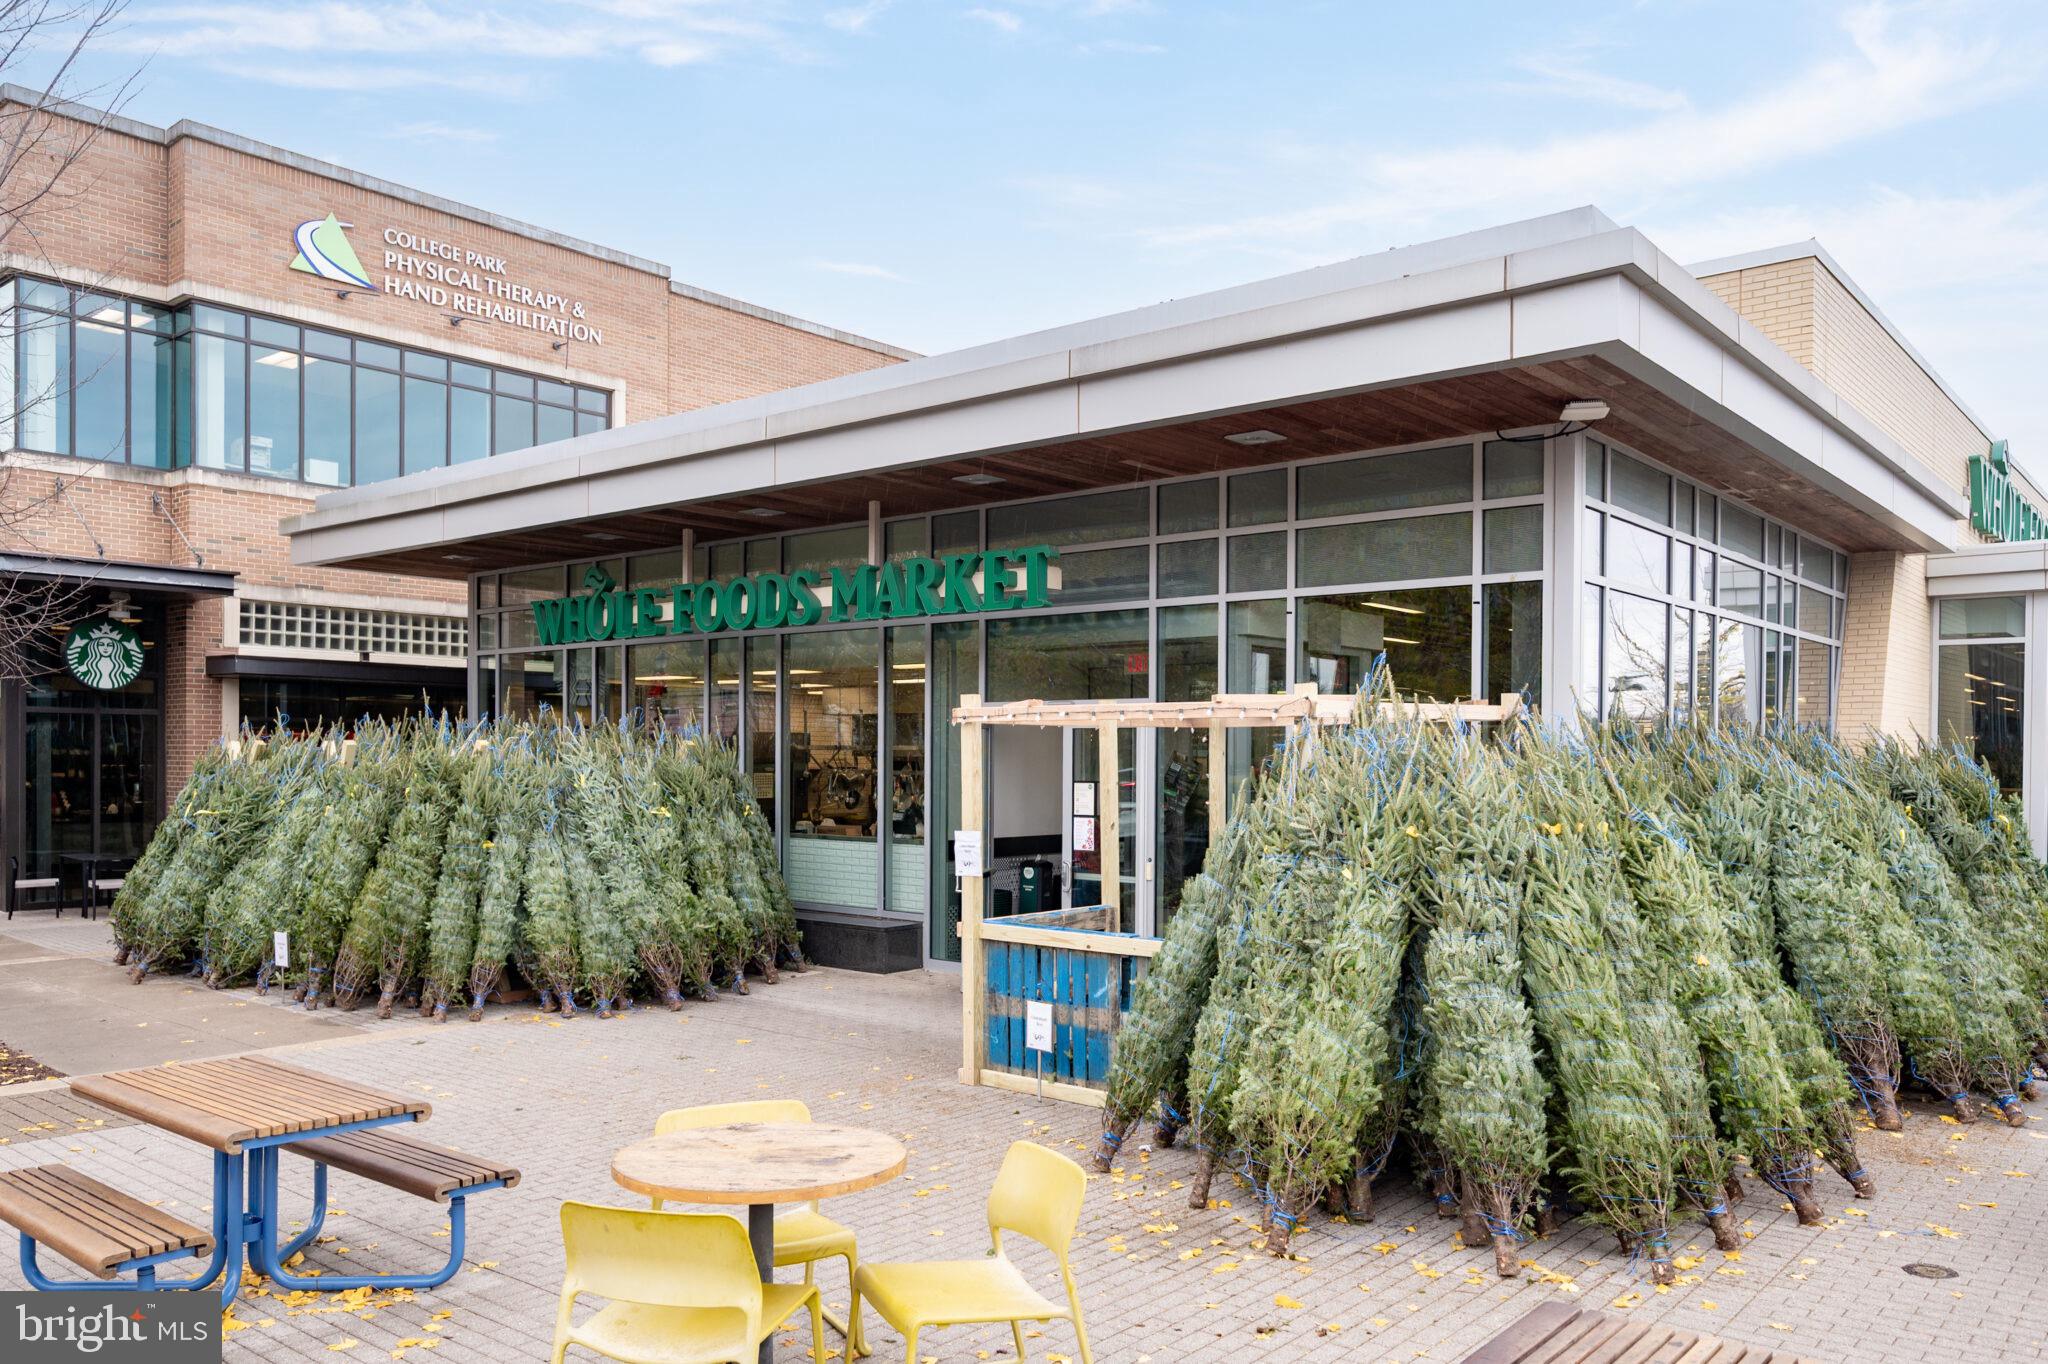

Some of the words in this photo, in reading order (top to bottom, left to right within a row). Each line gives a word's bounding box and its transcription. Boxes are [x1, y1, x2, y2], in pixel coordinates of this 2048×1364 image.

[384, 228, 461, 262] COLLEGE
[465, 249, 507, 275] PARK
[385, 250, 482, 292] PHYSICAL
[484, 276, 568, 313] THERAPY
[572, 301, 585, 319] &
[384, 274, 448, 306] HAND
[453, 292, 602, 345] REHABILITATION
[531, 567, 666, 646] WHOLE
[671, 569, 822, 633] FOODS
[828, 544, 1061, 622] MARKET
